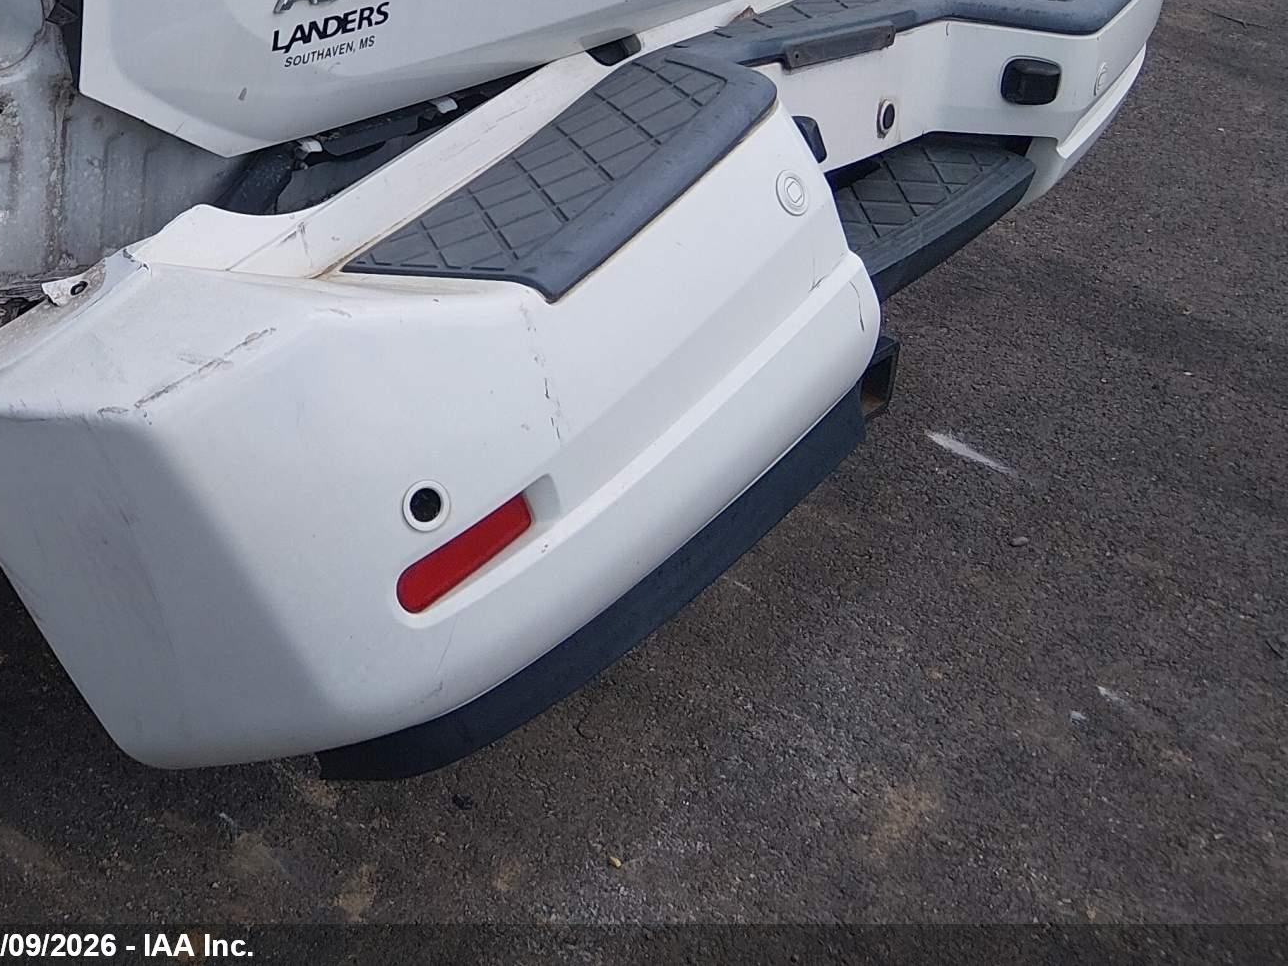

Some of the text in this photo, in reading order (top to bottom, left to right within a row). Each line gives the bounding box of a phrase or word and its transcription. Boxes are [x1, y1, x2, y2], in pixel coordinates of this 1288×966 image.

[271, 1, 390, 54] LANDERS
[284, 34, 376, 68] SOUTHAVEN, MS
